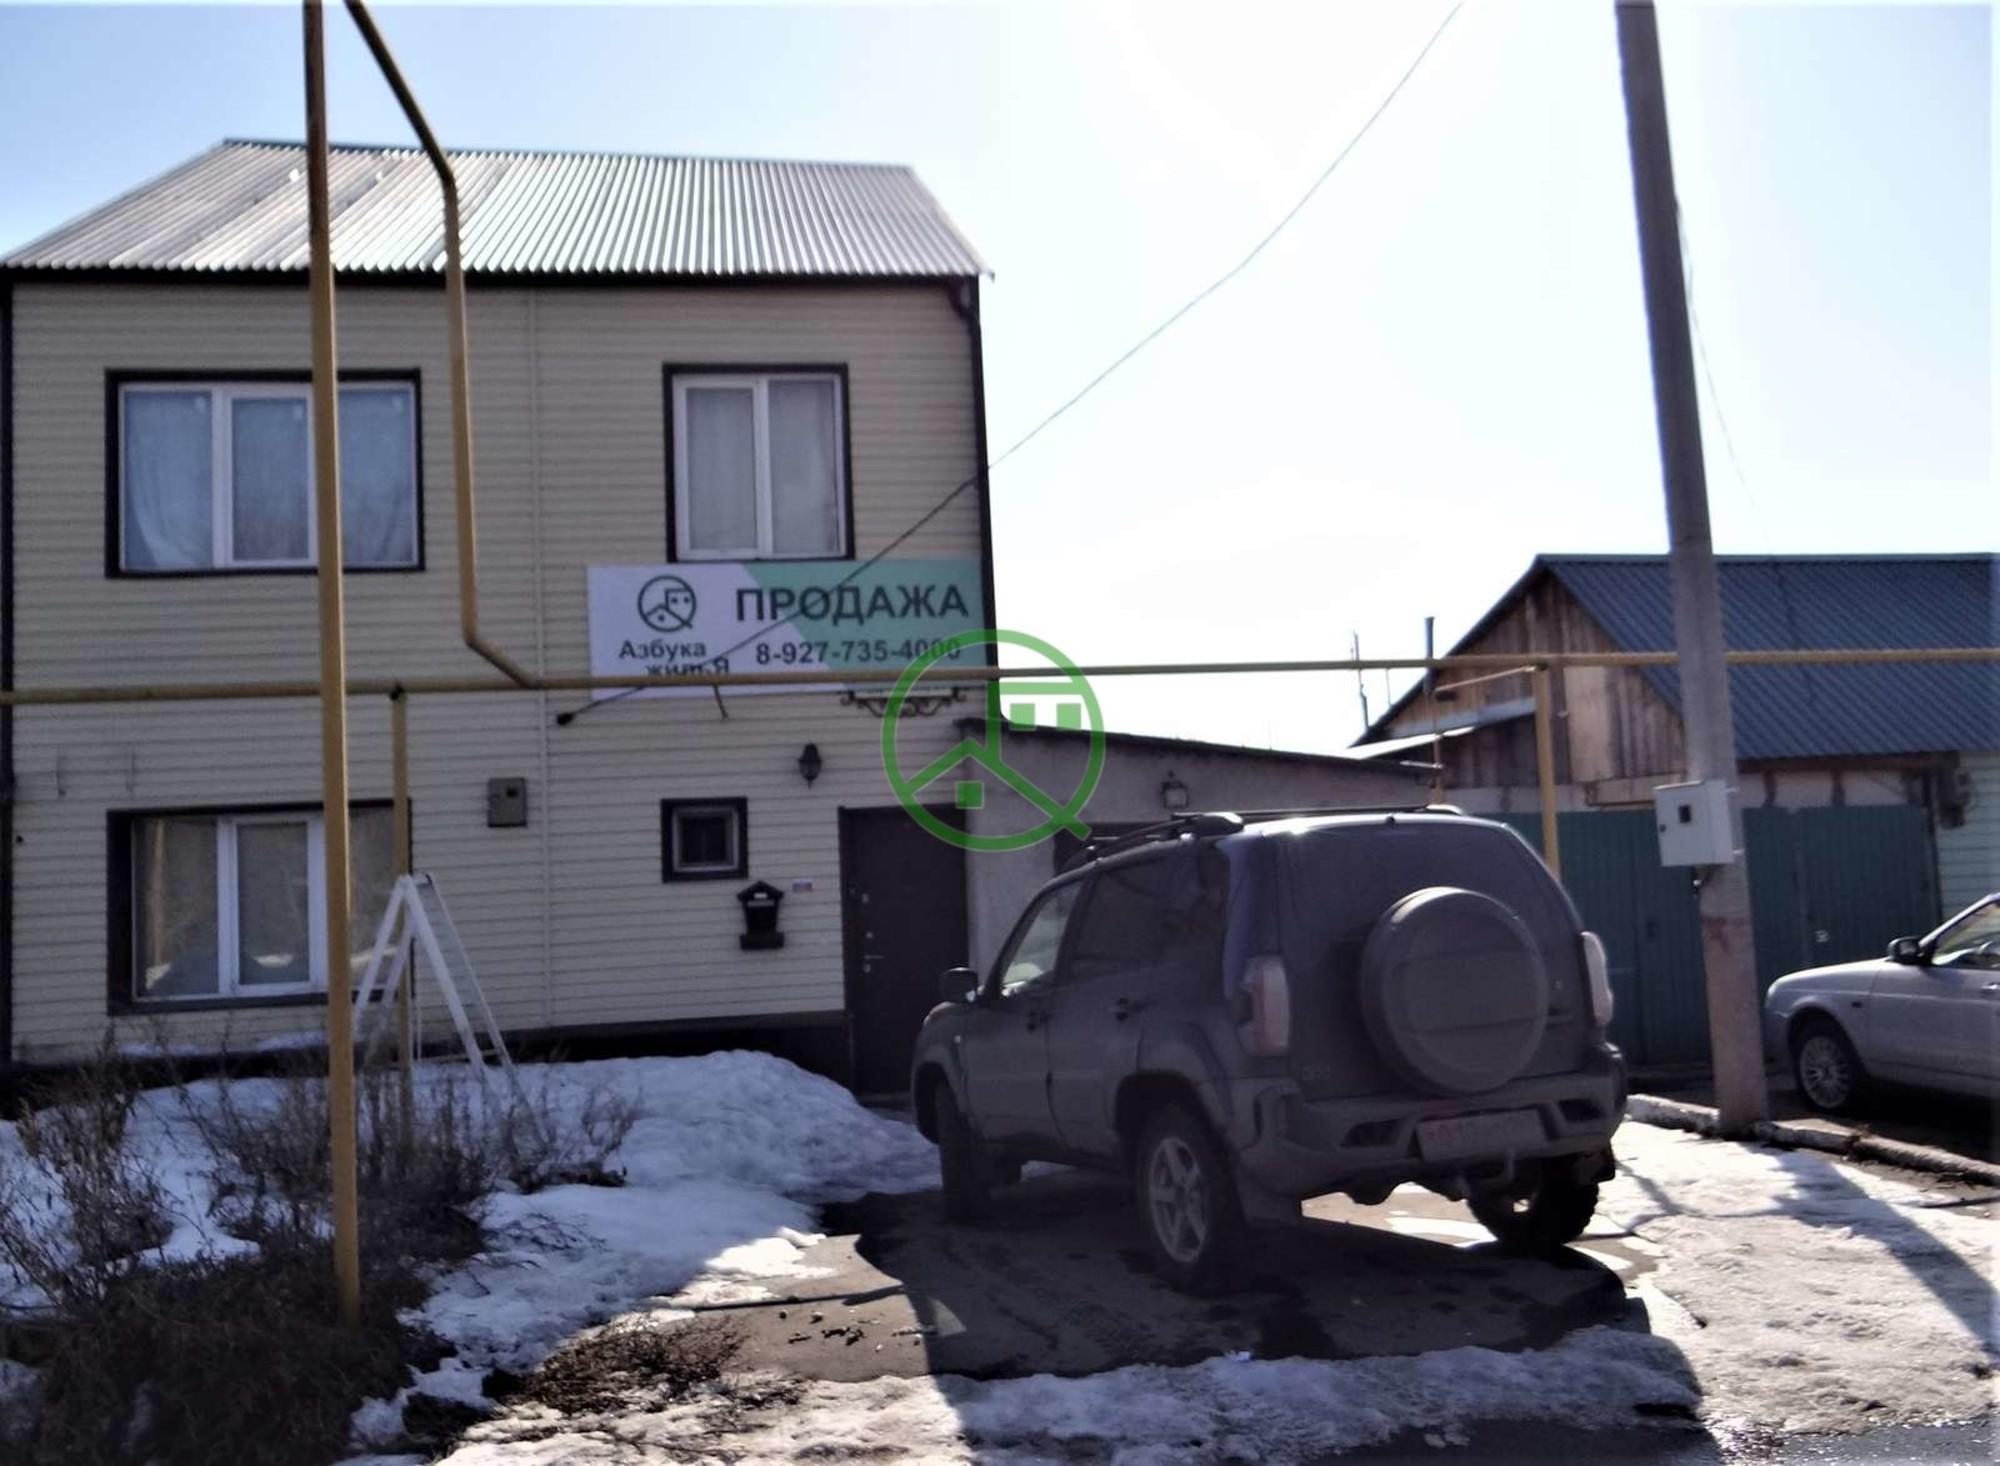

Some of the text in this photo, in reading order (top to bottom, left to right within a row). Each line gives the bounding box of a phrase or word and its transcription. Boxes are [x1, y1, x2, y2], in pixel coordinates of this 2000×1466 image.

[736, 584, 969, 625] ПРОДАЖА
[618, 638, 707, 663] Азбука
[755, 637, 961, 666] 8-927-735-4000
